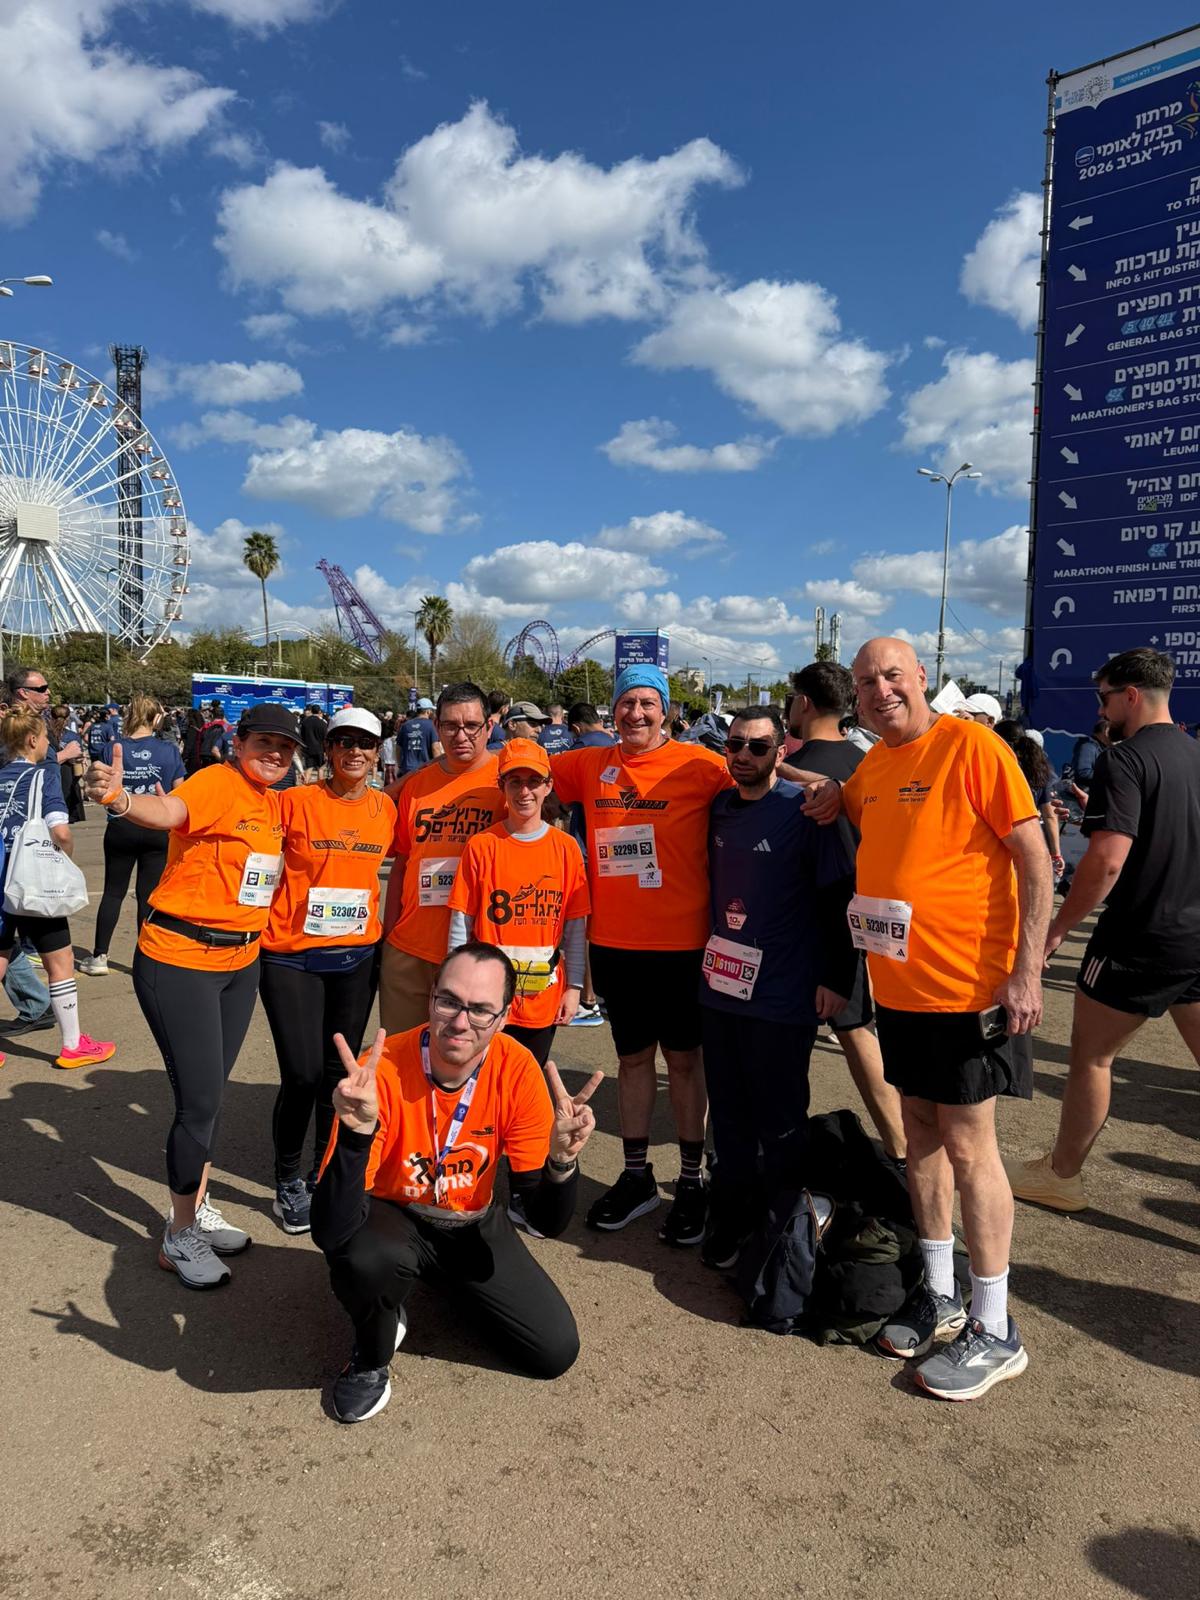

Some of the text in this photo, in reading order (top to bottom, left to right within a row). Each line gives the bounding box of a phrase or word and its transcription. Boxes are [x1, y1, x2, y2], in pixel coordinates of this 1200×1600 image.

[1135, 101, 1183, 130] מרתון
[1096, 124, 1175, 157] בנק לאומי
[1079, 160, 1114, 181] 2026
[1166, 200, 1182, 212] TO
[1114, 247, 1171, 275] ערכות
[1106, 276, 1132, 290] INFO
[1133, 273, 1142, 283] &
[1143, 268, 1162, 281] KIT
[1117, 291, 1173, 317] חפצים
[1107, 334, 1157, 351] GENERAL
[1159, 328, 1184, 342] BAG
[1114, 360, 1170, 384] חפצים
[1156, 396, 1180, 408] BAG
[1124, 426, 1175, 449] לאומי
[1163, 443, 1199, 457] LEUMI
[1180, 491, 1199, 503] IDF
[1120, 524, 1158, 542] סיום
[1163, 522, 1184, 541] קו
[1054, 565, 1114, 579] MARATHON
[1115, 562, 1150, 574] FINISH
[1151, 560, 1177, 571] LINE
[1112, 586, 1168, 604] רפואה
[455, 807, 493, 824] מרוץ
[415, 807, 434, 843] 5
[613, 843, 638, 856] 52299
[535, 889, 564, 907] מרוץ
[331, 905, 357, 918] 52302
[486, 889, 513, 926] 8
[514, 903, 562, 919] אתגרים
[866, 918, 889, 936] 52301
[719, 958, 740, 975] 61107
